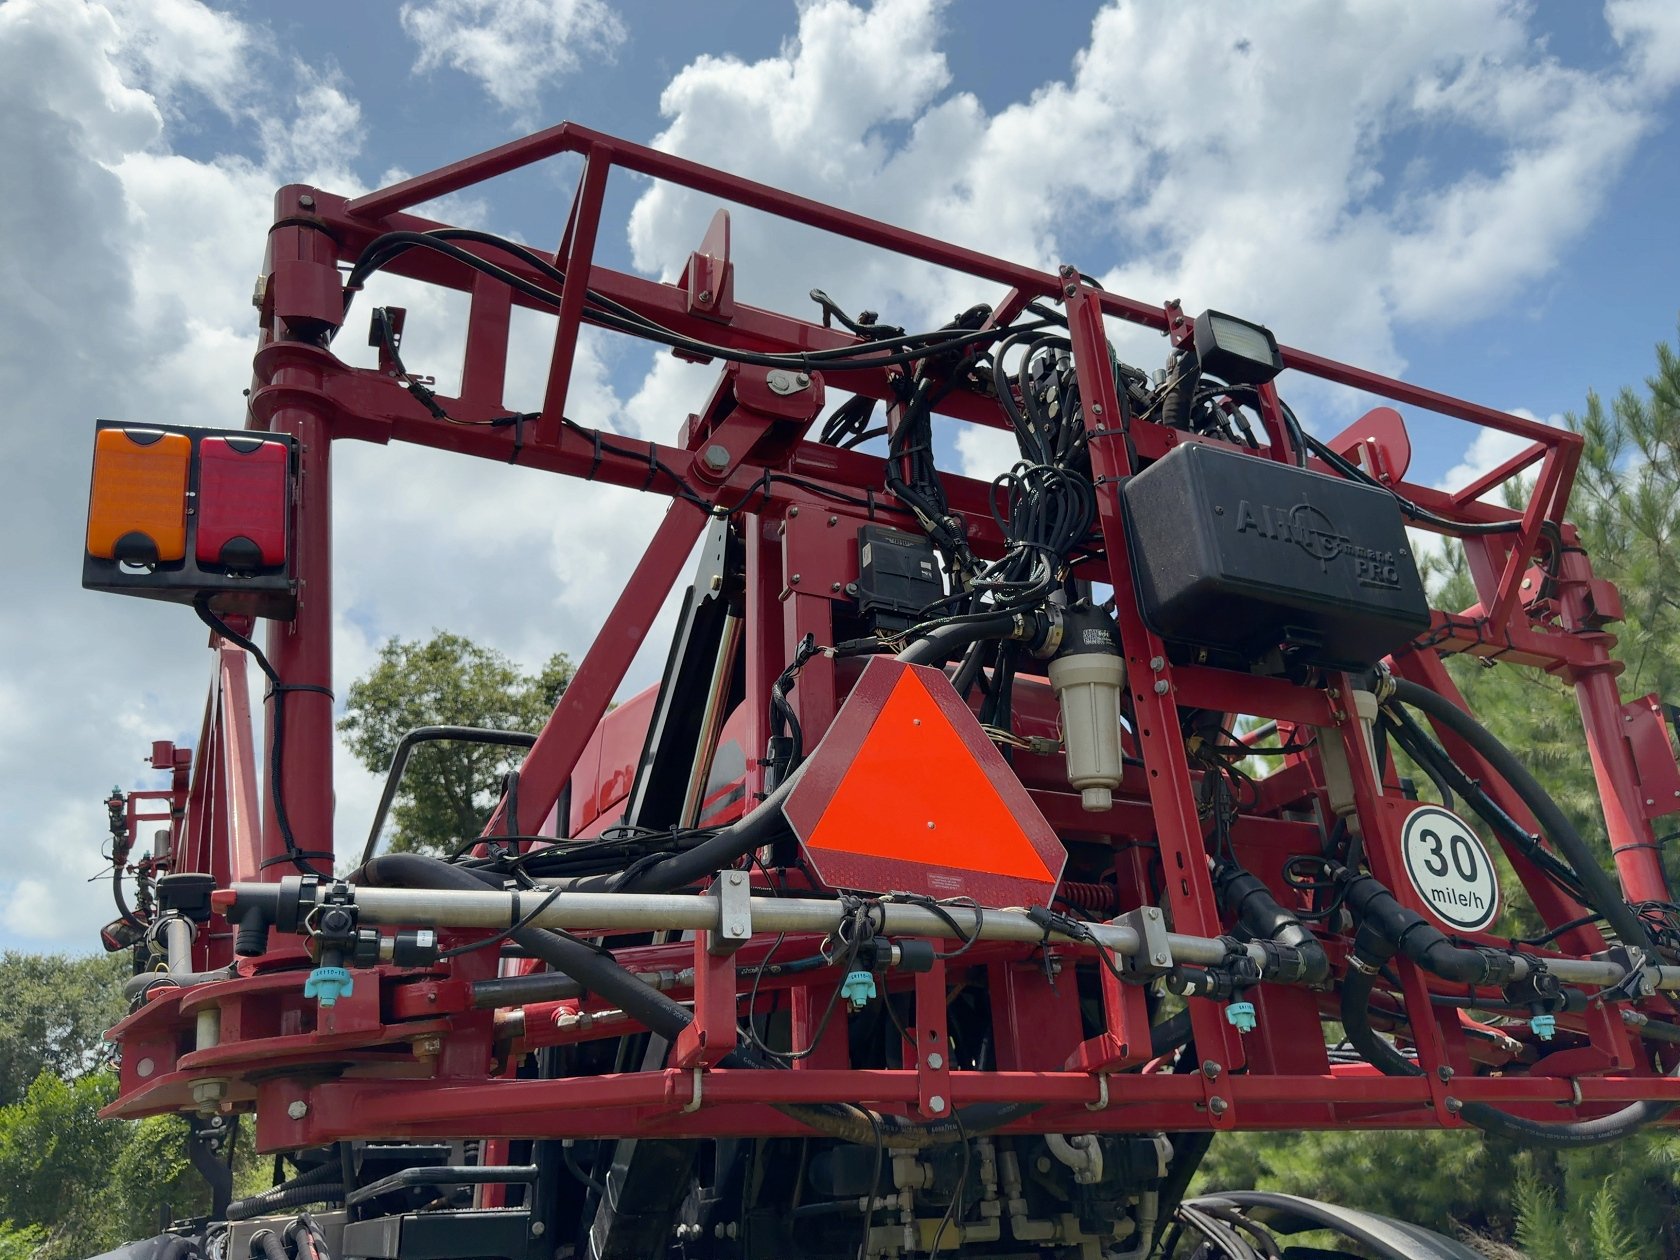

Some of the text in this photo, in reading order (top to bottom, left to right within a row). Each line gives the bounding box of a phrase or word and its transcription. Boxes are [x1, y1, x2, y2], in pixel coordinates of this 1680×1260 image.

[1355, 558, 1400, 585] PRO
[1420, 829, 1477, 882] 30
[1431, 887, 1484, 909] mile/h
